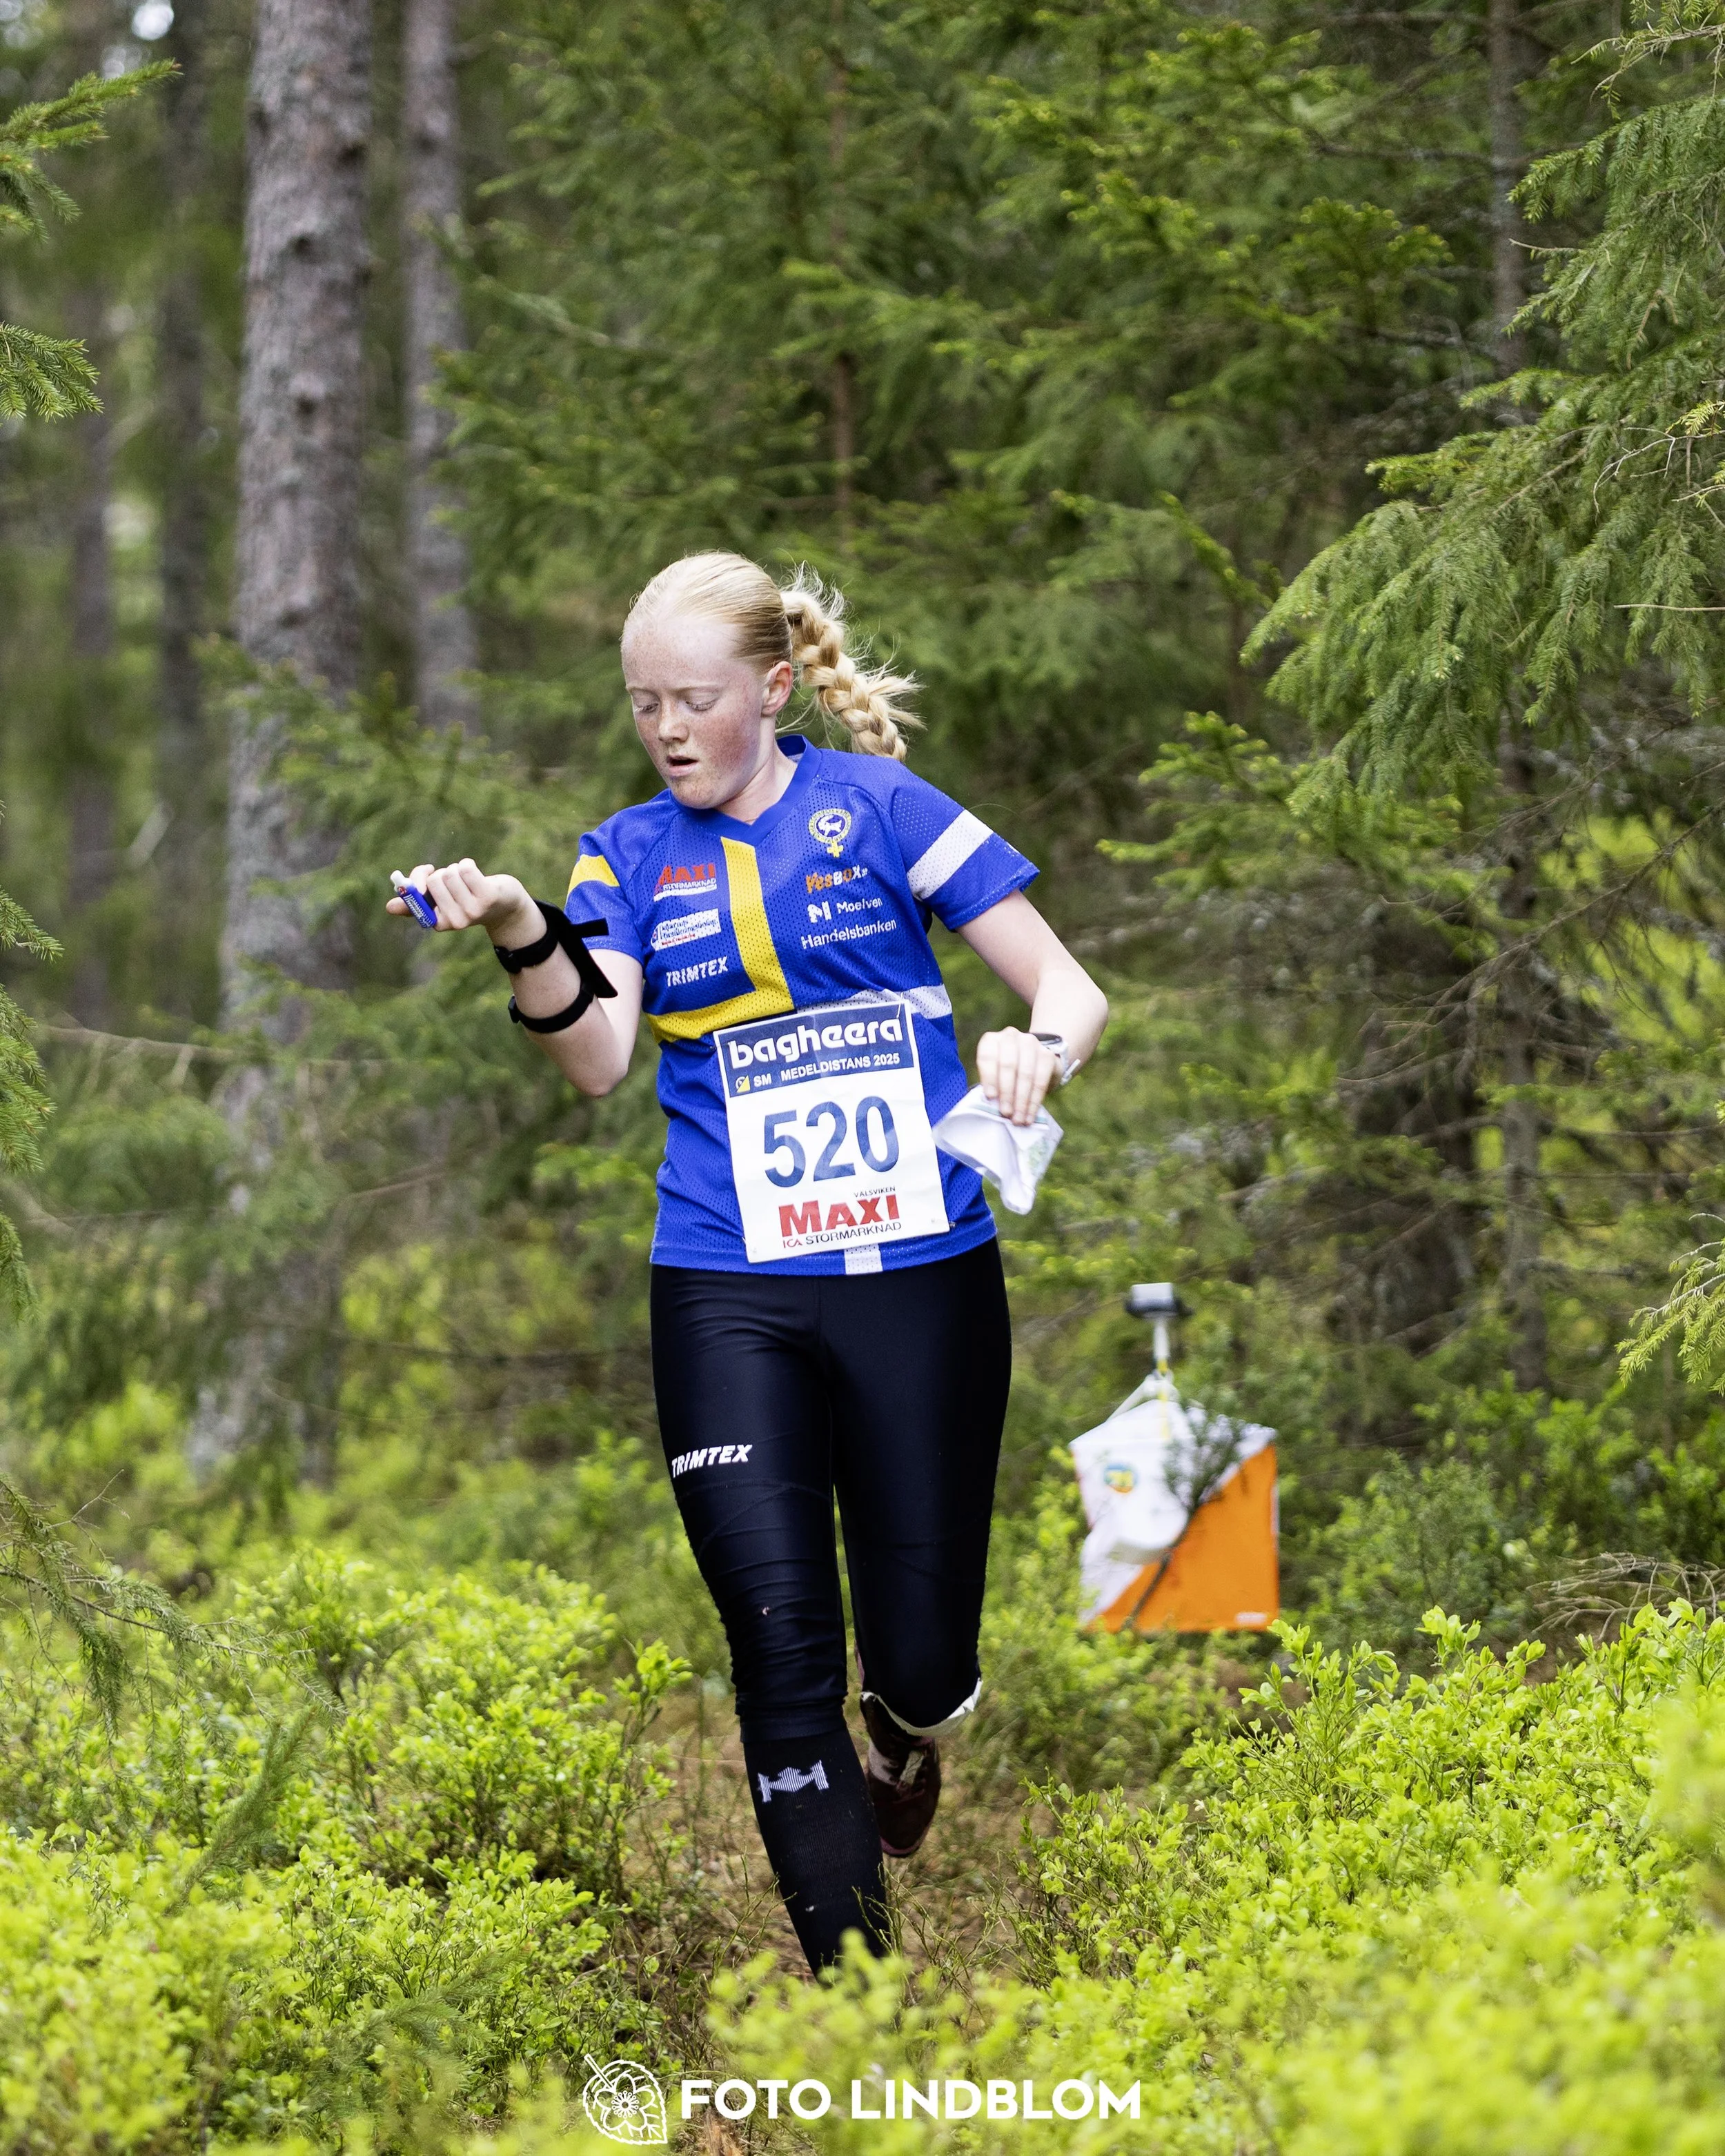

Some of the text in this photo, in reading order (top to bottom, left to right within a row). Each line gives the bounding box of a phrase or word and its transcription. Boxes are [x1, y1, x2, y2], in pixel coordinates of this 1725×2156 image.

[836, 898, 883, 914] Moelven
[801, 920, 896, 949] Handelsbanken
[666, 956, 728, 987] TRIMTEX
[727, 1018, 903, 1069] bagheera
[753, 1053, 900, 1087] SM MEDELDISTANS 2025
[764, 1096, 899, 1187] 520
[778, 1194, 900, 1237] MAXI
[782, 1222, 902, 1249] ICA STORMARKNAD
[672, 1444, 753, 1478] TRIMTEX
